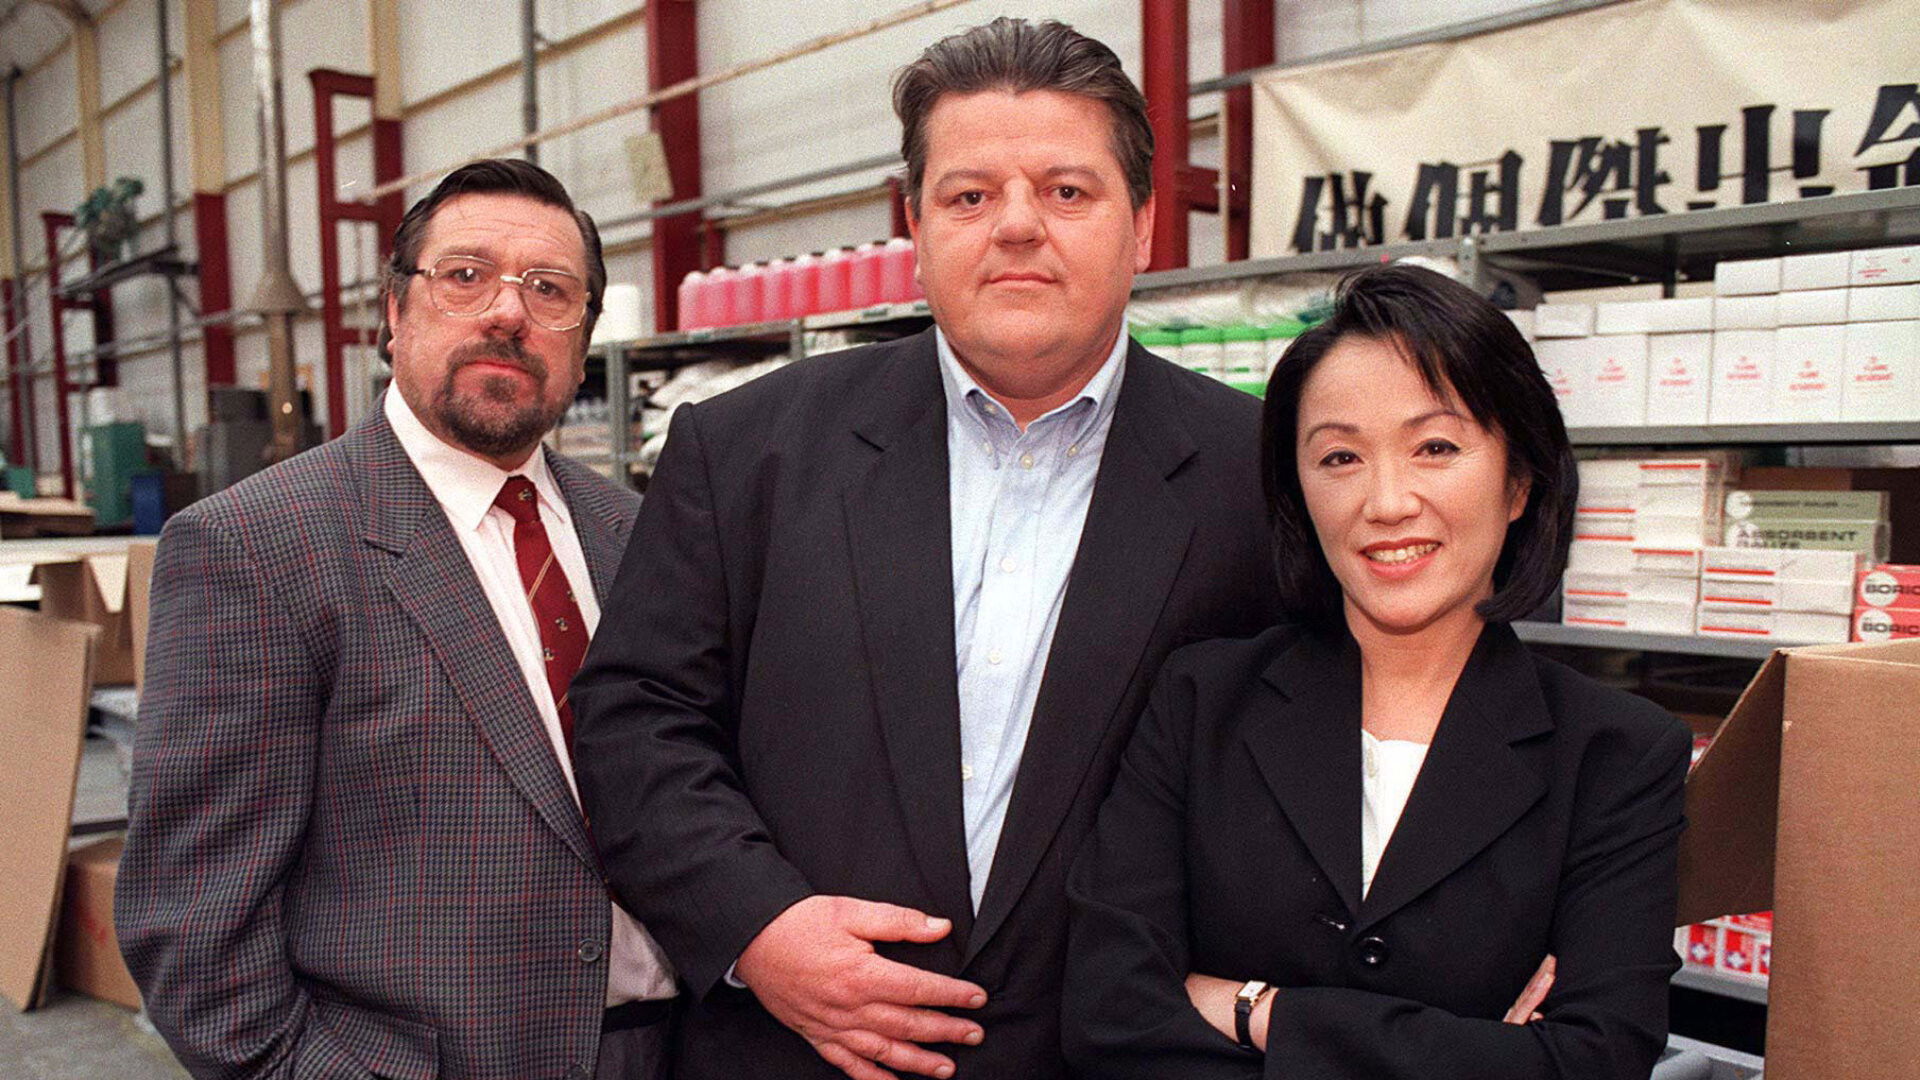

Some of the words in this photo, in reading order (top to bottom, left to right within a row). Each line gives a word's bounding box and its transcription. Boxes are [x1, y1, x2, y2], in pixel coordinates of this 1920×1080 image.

[1290, 83, 1920, 253] 做個傑出
[1736, 530, 1857, 541] ABSORBENT
[1862, 622, 1920, 635] BORIC
